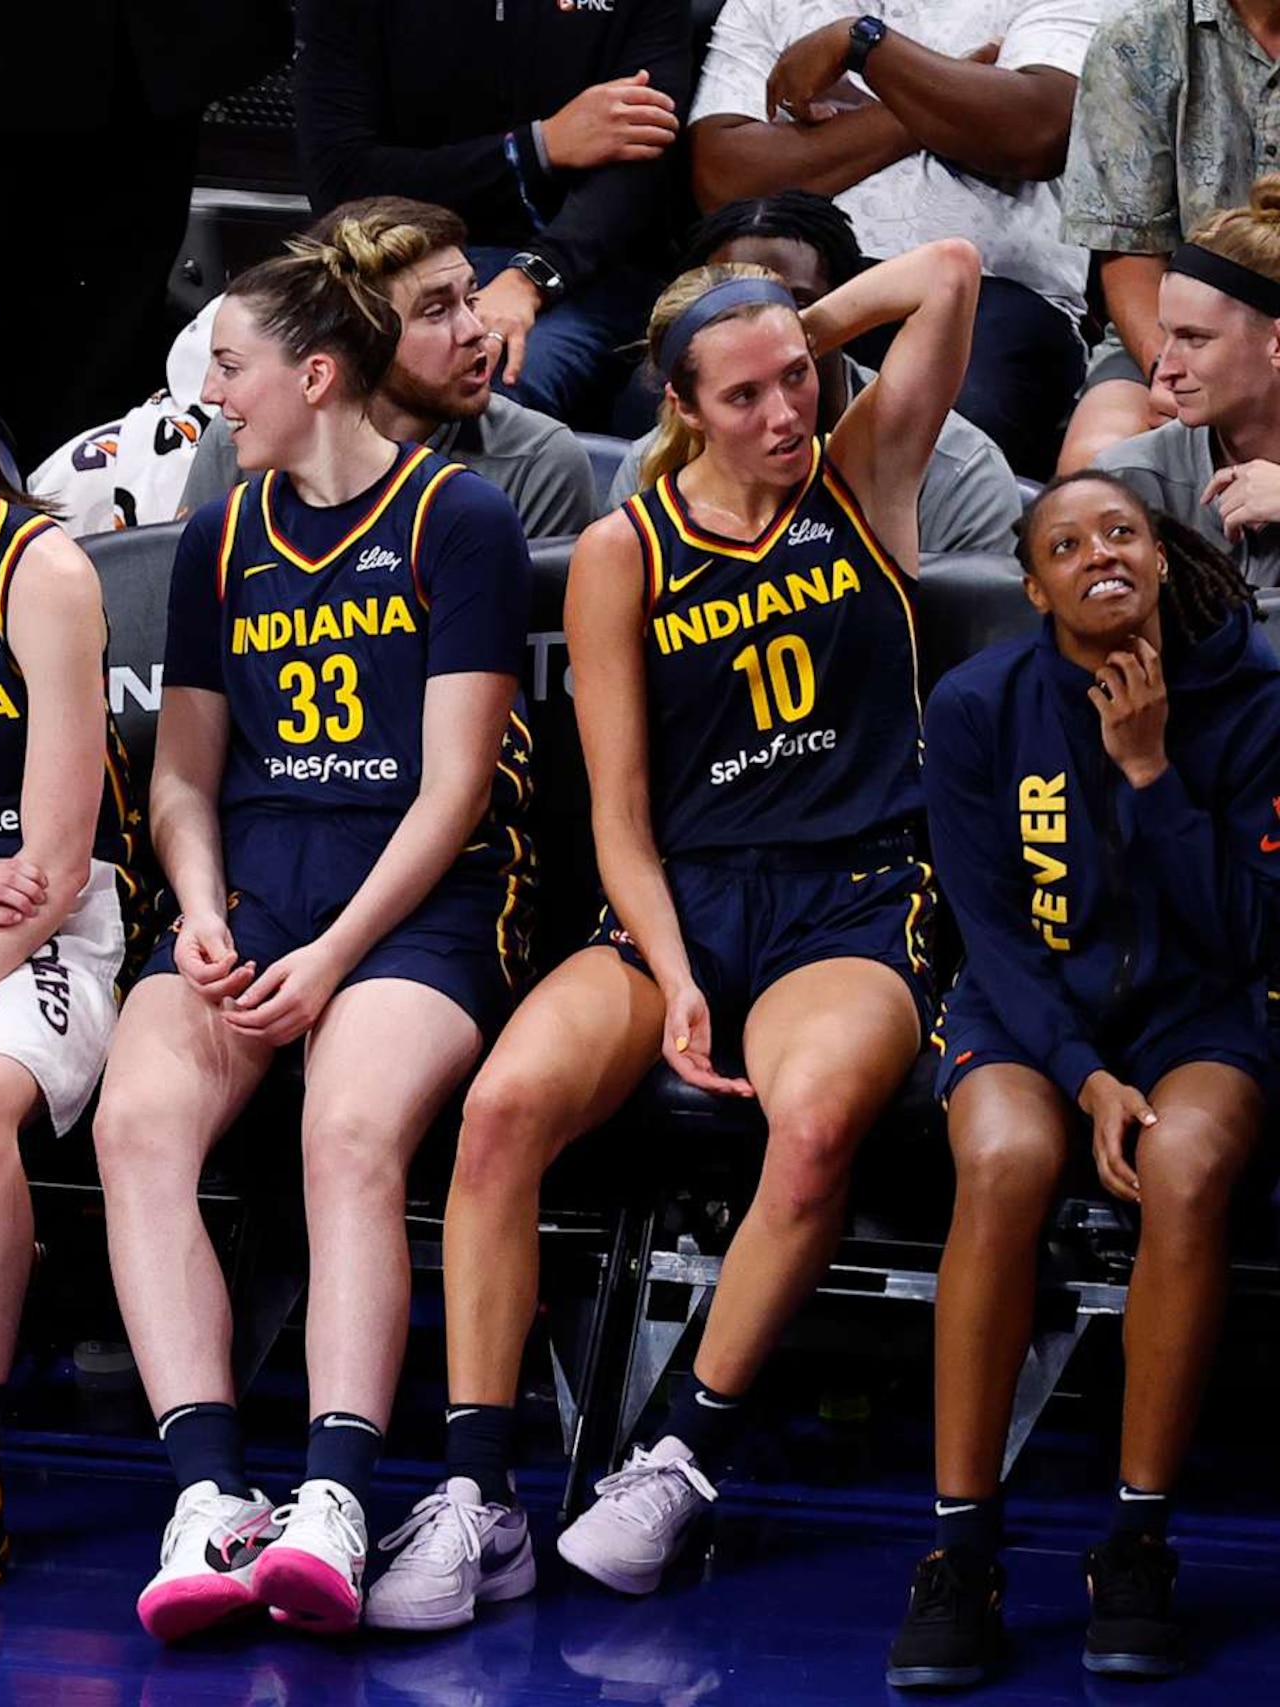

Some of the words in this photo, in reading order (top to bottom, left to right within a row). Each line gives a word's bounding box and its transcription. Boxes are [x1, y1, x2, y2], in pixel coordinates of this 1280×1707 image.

[356, 545, 402, 573] Lilly
[788, 518, 835, 546] Lilly
[232, 595, 417, 655] INDIANA
[653, 558, 861, 656] INDIANA
[277, 653, 364, 744] 33
[733, 634, 815, 731] 10
[264, 753, 399, 783] alesforce
